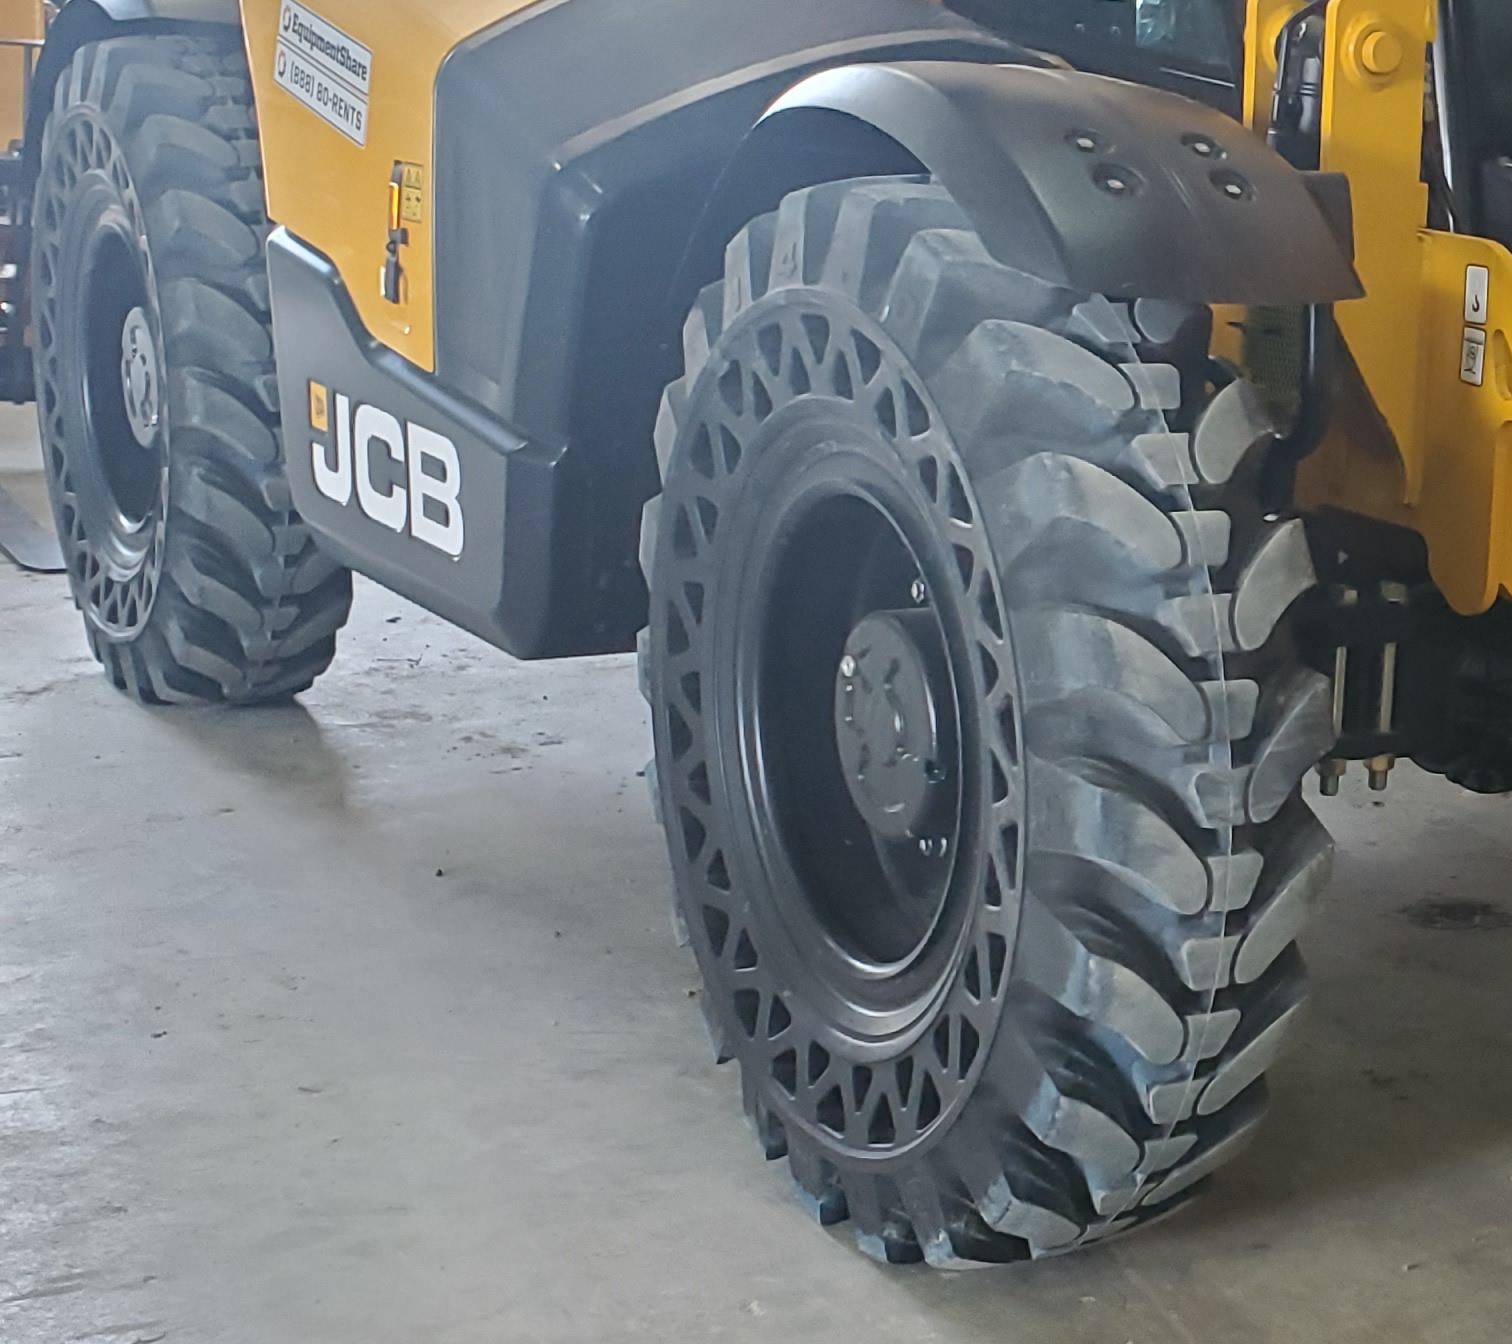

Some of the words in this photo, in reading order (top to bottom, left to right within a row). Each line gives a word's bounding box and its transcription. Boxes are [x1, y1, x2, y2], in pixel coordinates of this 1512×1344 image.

[291, 12, 367, 82] EquipmentShare
[290, 60, 315, 97] (888)
[316, 83, 363, 131] 80-RENTS
[311, 392, 465, 560] JCB
